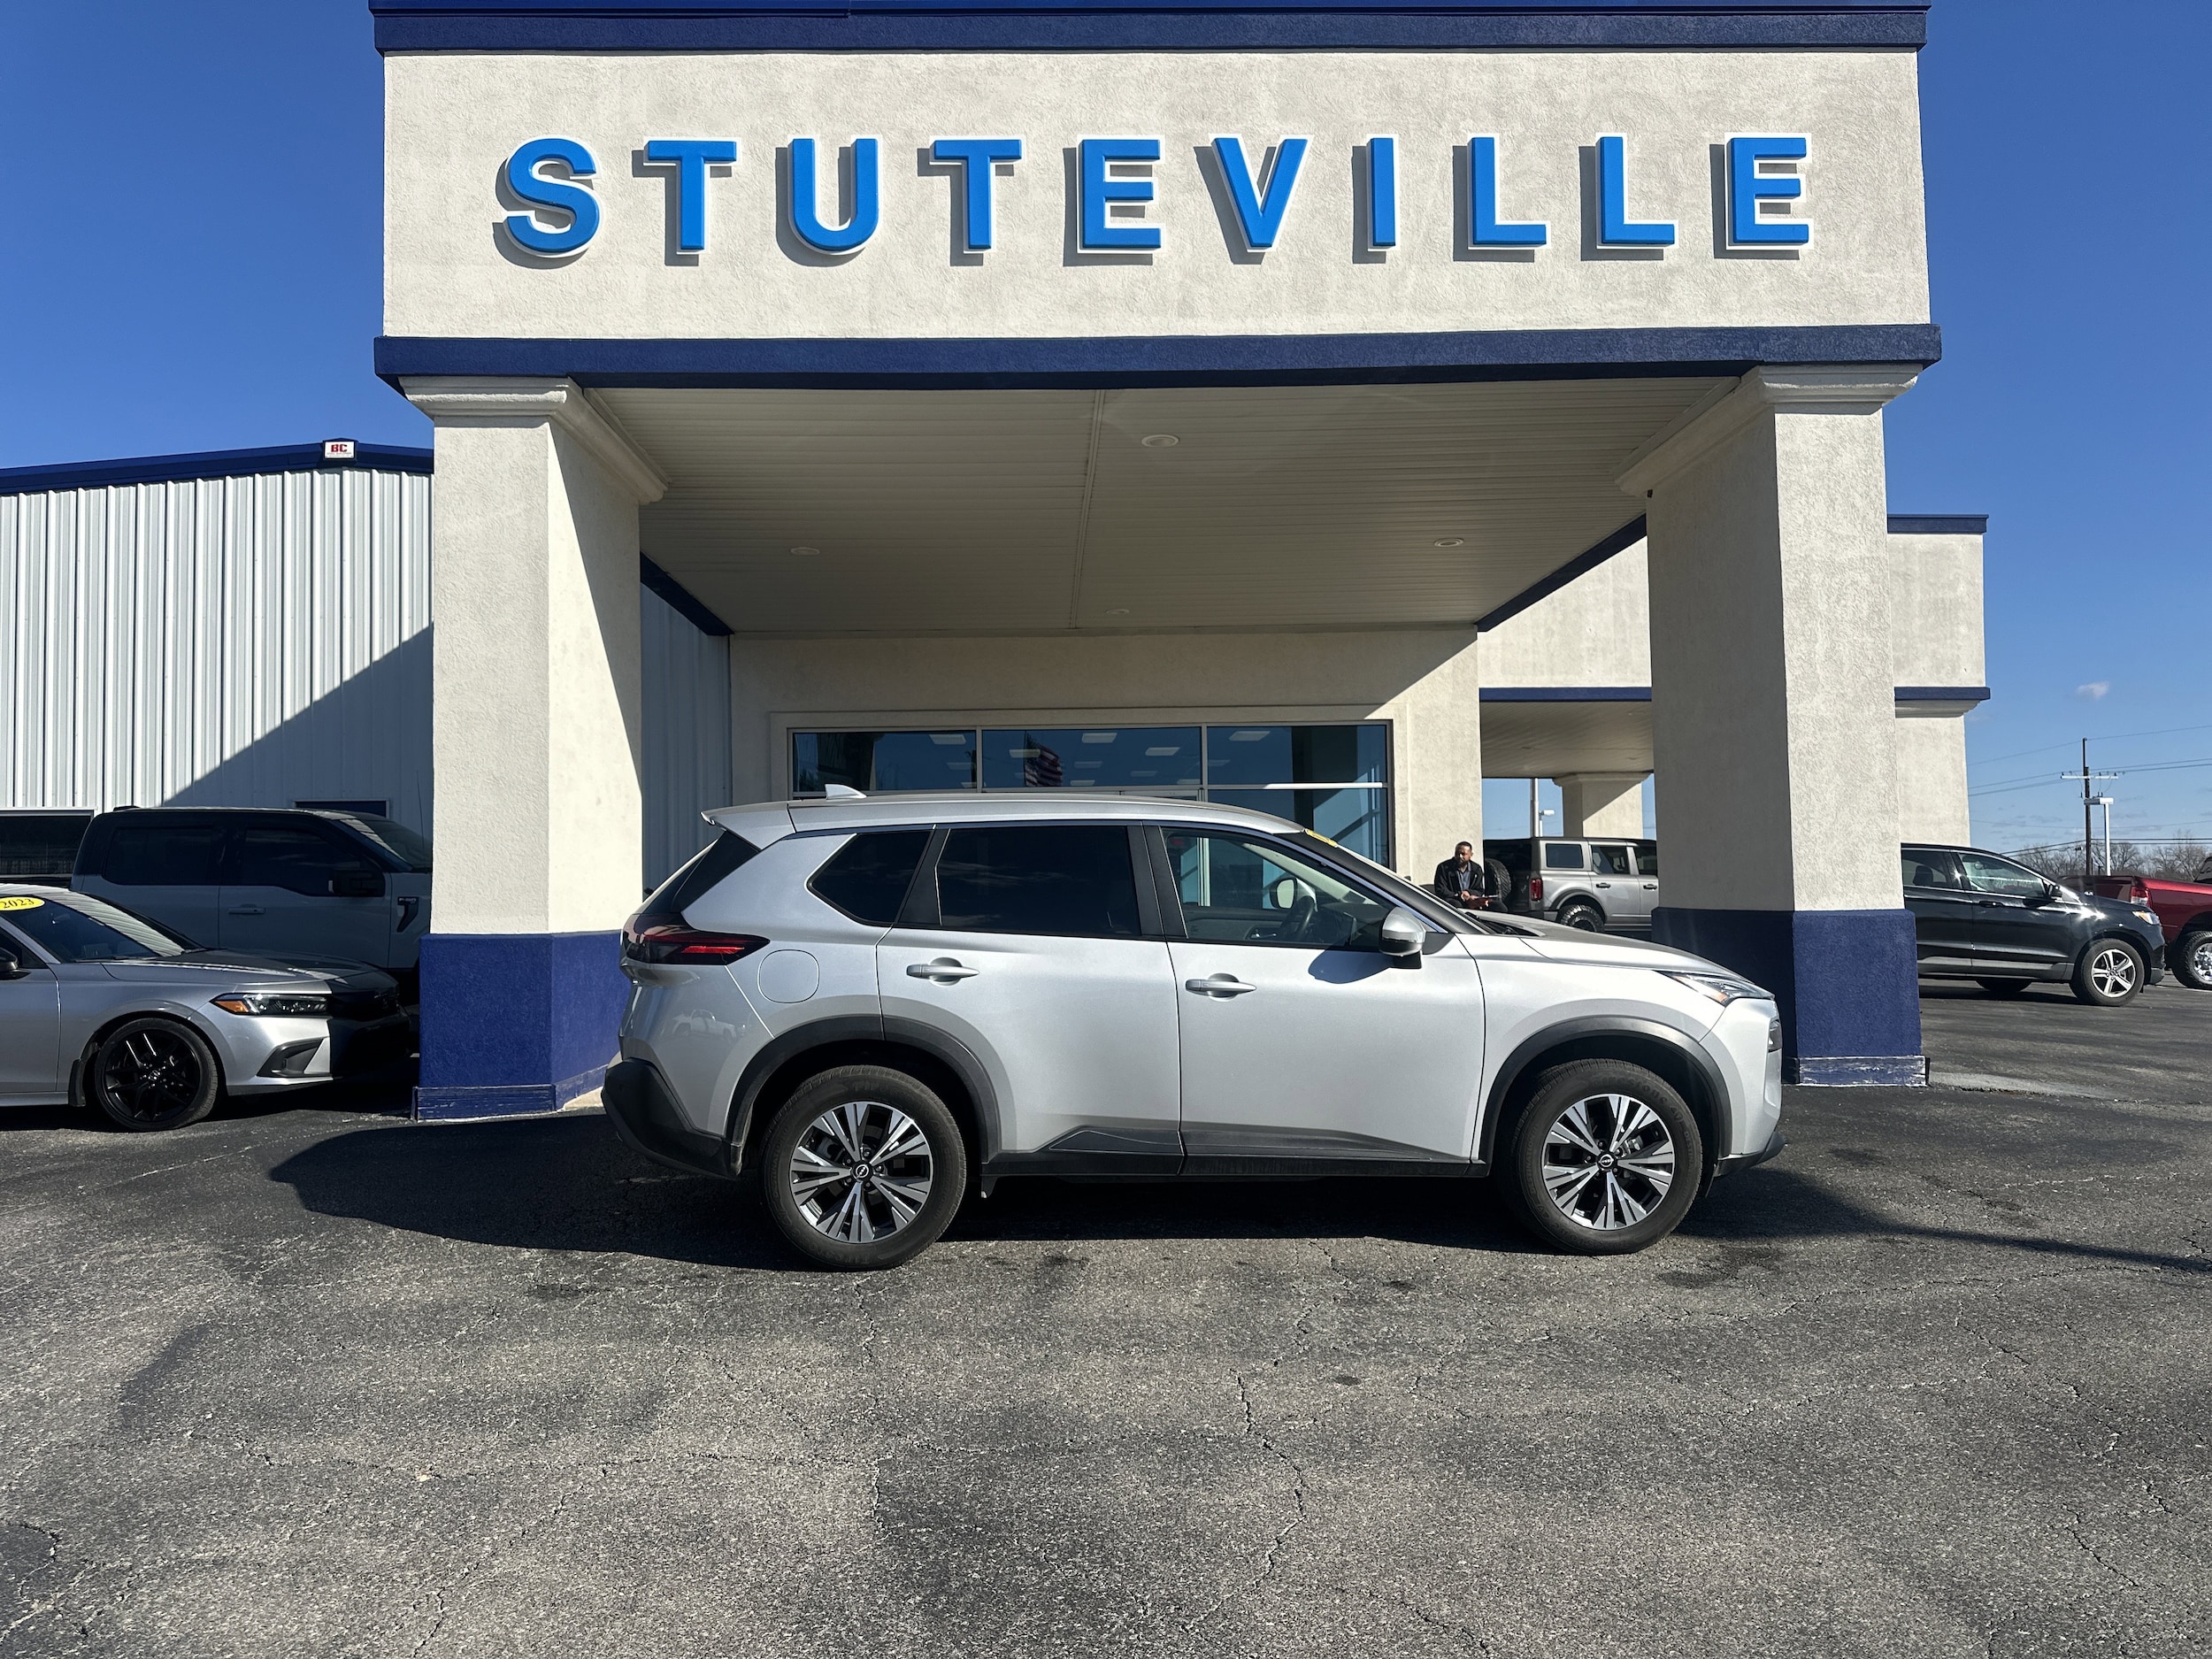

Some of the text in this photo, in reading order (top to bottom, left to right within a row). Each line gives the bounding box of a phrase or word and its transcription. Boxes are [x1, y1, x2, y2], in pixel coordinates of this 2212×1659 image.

[504, 135, 1811, 255] STUTEVILLE
[331, 443, 348, 452] BC
[1, 898, 35, 909] 2023
